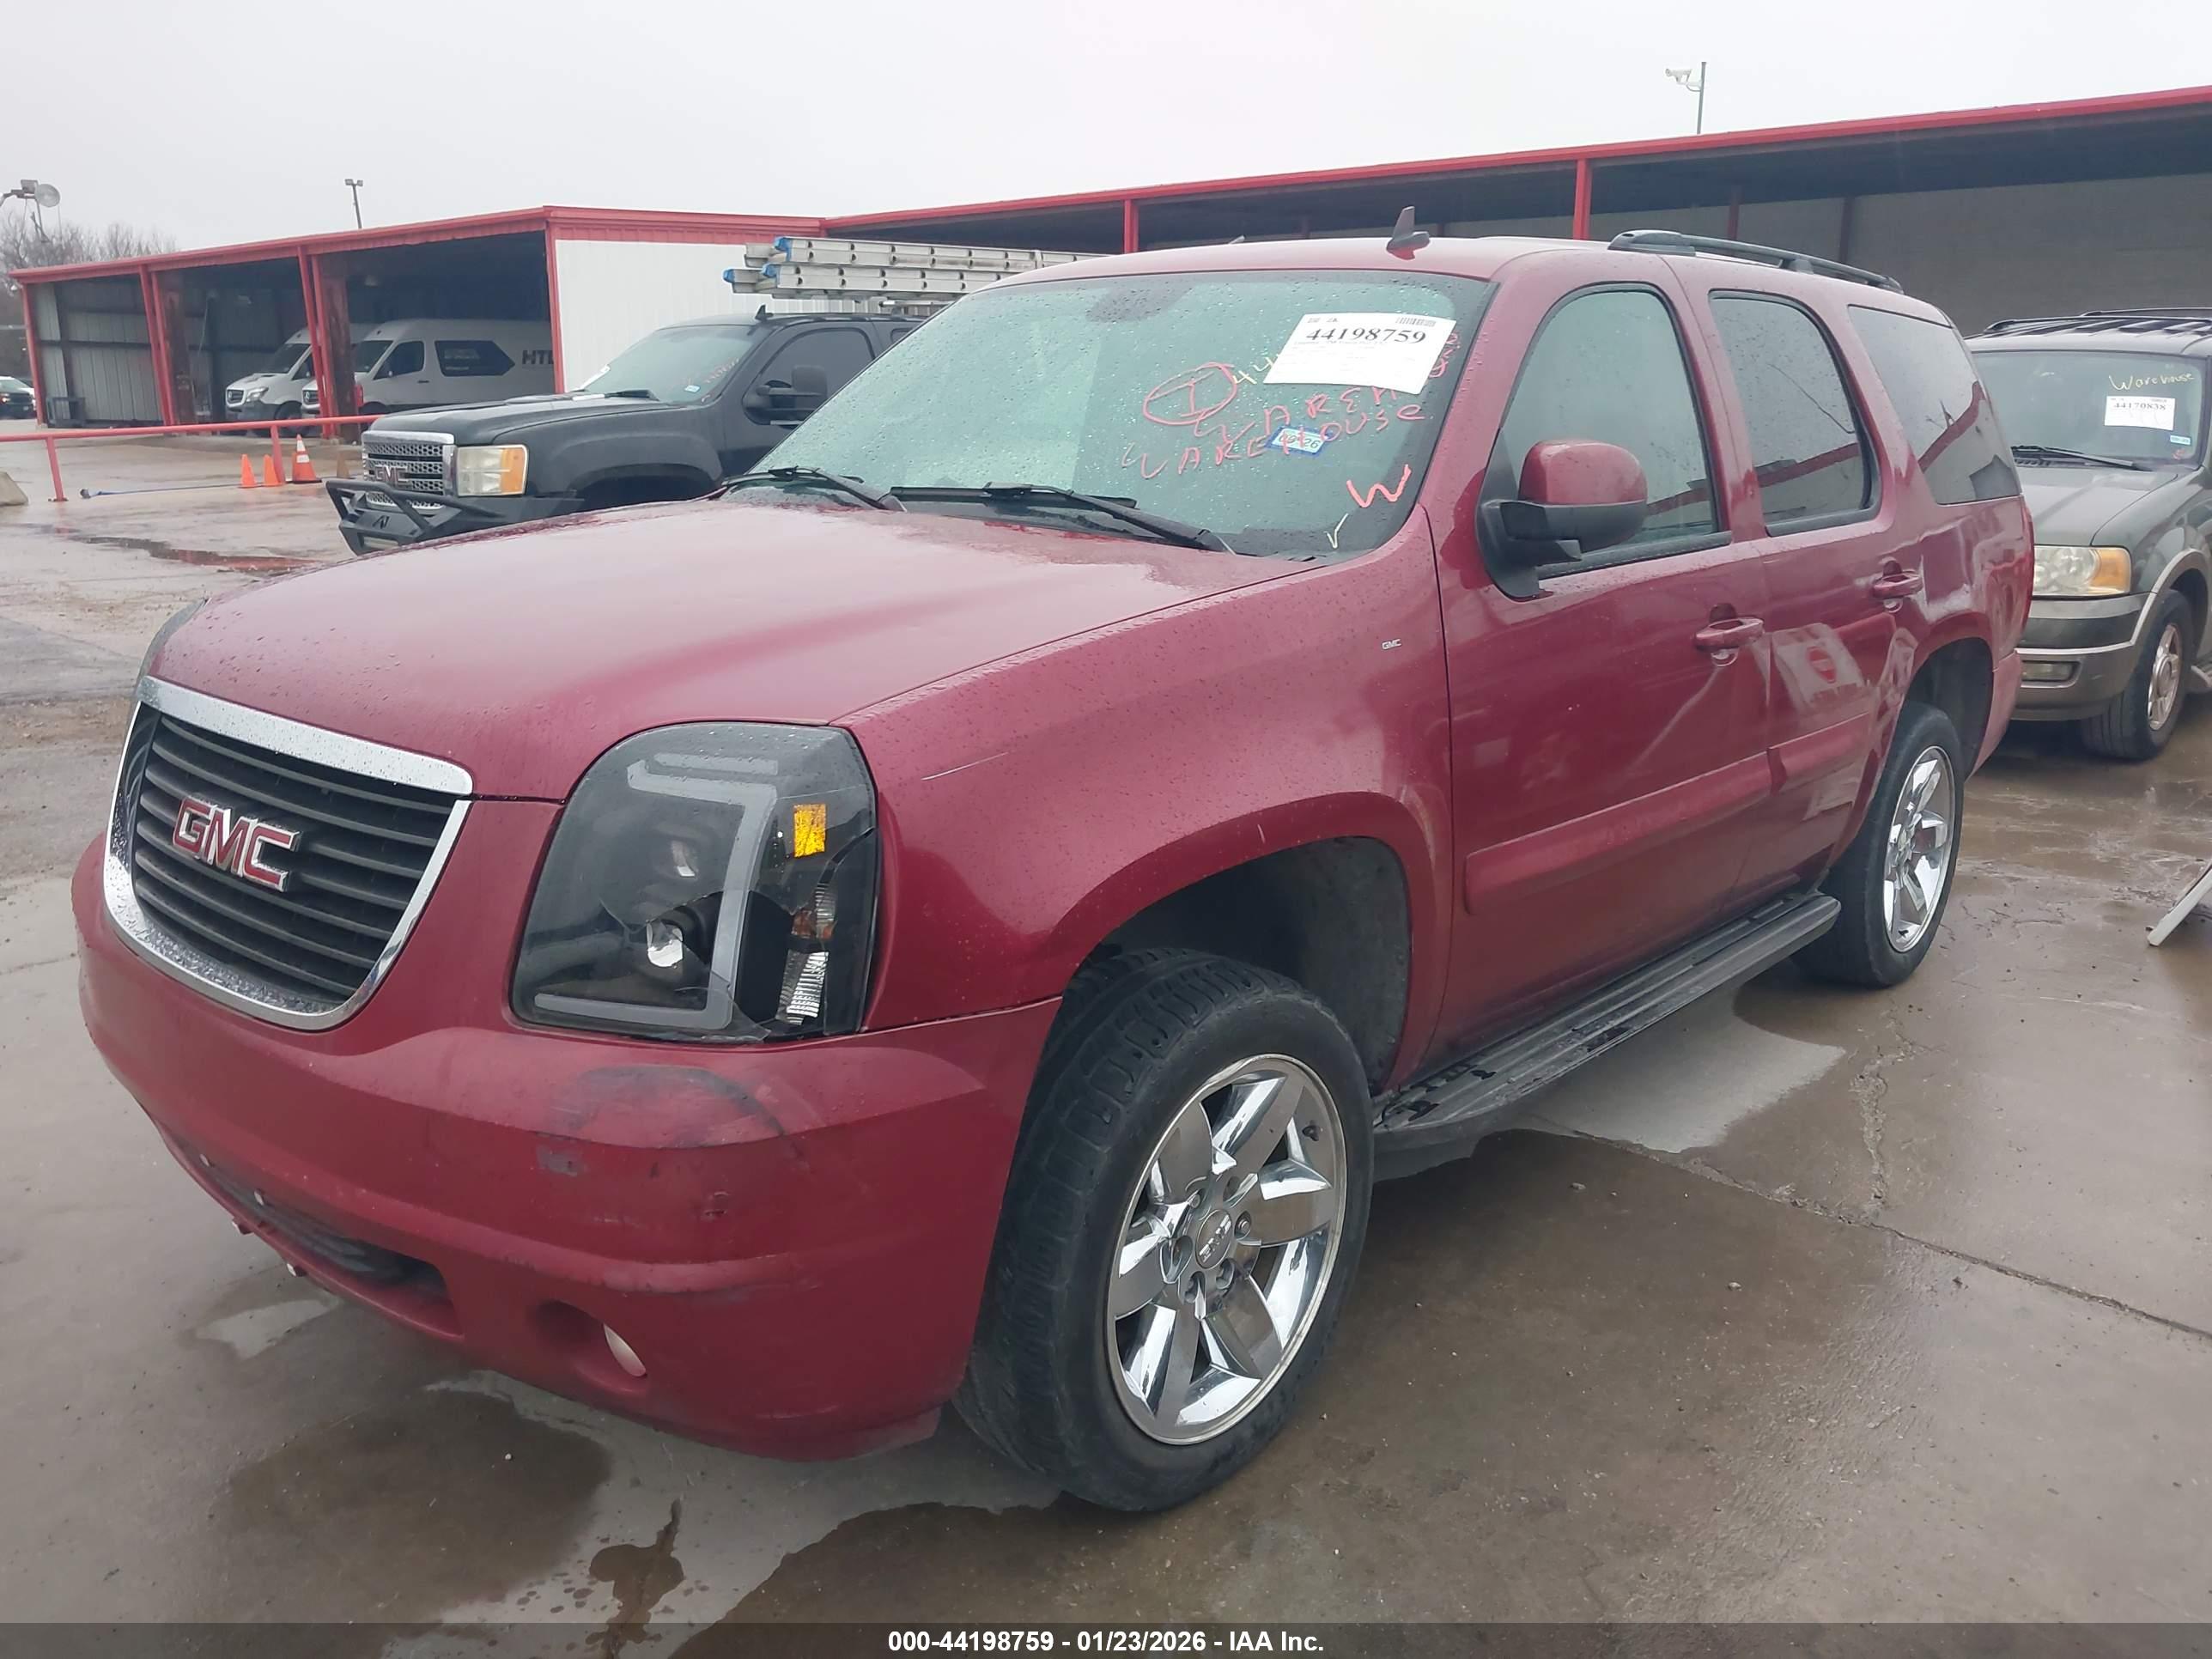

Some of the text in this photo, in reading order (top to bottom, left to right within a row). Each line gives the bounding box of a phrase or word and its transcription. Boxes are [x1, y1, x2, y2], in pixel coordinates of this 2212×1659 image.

[1306, 327, 1426, 343] 44198759
[1382, 639, 1401, 650] GMC
[172, 793, 301, 892] GMC
